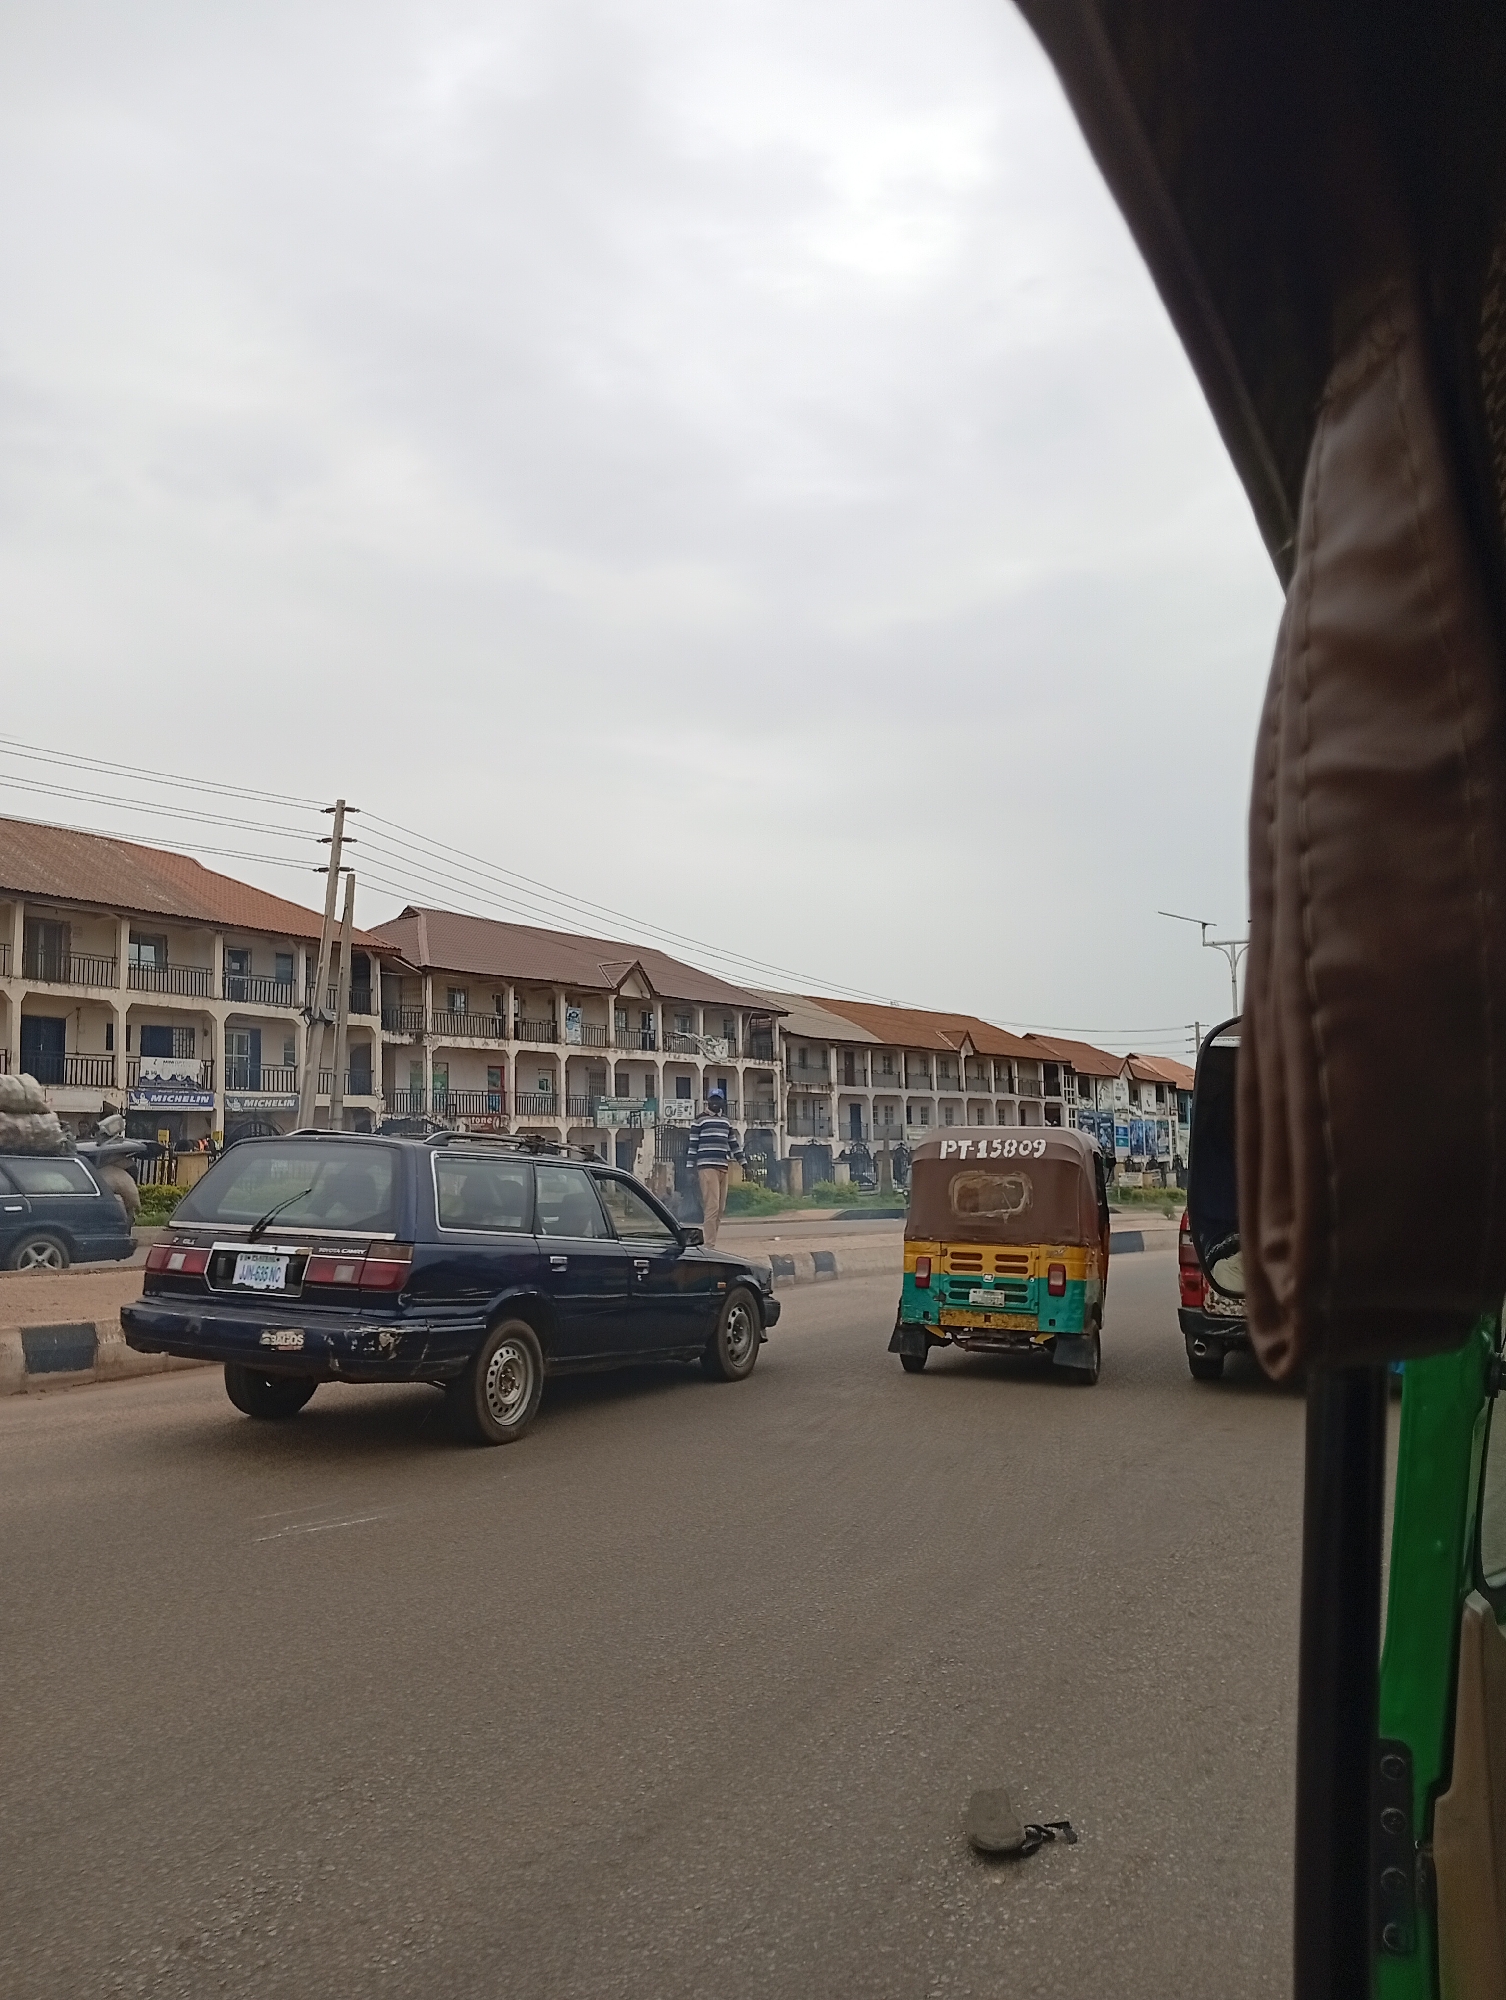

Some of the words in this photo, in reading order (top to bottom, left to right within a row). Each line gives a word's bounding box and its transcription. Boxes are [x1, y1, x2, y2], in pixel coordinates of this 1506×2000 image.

[150, 1094, 210, 1104] MICHELIN
[244, 1099, 295, 1108] MICHELIN
[939, 1139, 1047, 1160] PT-15809
